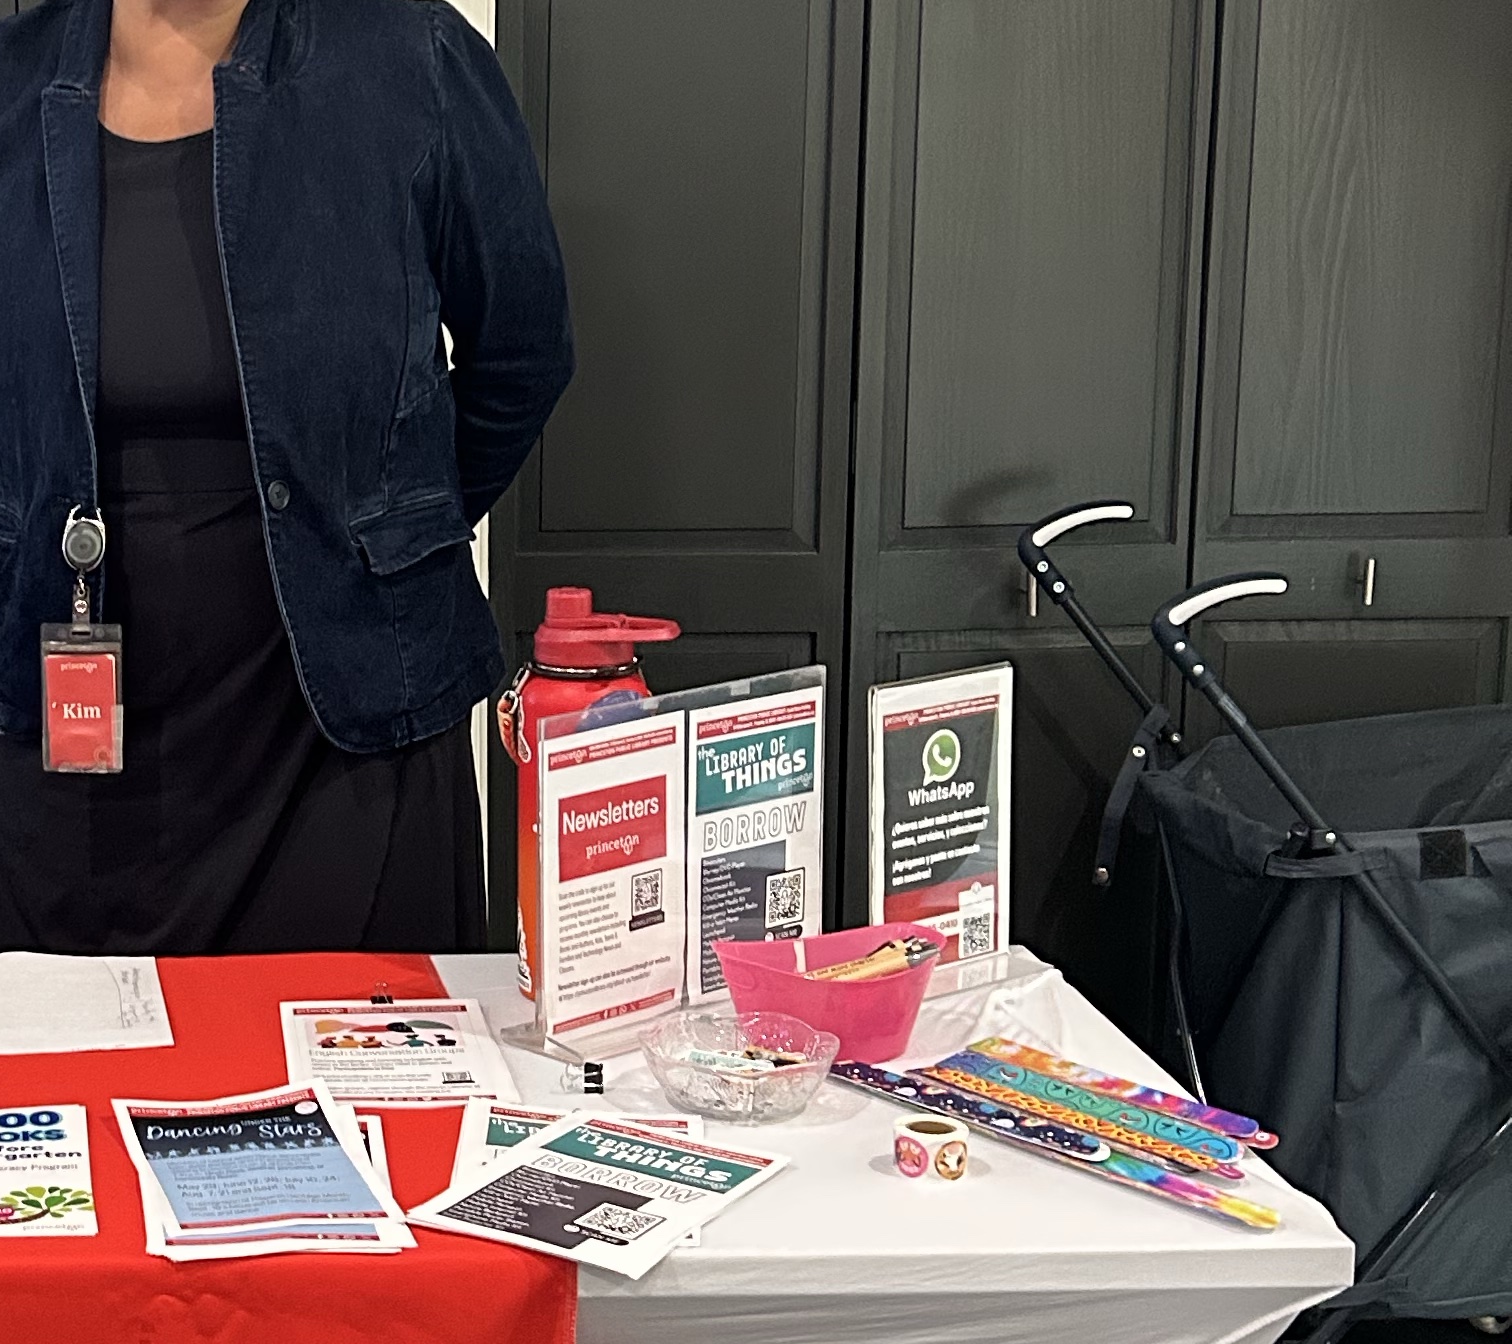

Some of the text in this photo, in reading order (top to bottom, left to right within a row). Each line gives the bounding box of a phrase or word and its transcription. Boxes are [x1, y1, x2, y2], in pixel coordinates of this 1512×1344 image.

[63, 703, 102, 719] Kim
[698, 745, 716, 761] the
[705, 735, 786, 776] LIBRARY OF
[721, 748, 807, 794] THINGS
[908, 780, 975, 807] WhatsApp
[562, 796, 660, 835] Newsletters
[703, 800, 807, 853] BORROW
[586, 834, 639, 860] princeton
[146, 1122, 323, 1140] Dancing Stars
[274, 1115, 292, 1124] THE
[575, 1126, 601, 1139] the
[578, 1133, 710, 1167] LIBRARY OF
[593, 1142, 732, 1183] THINGS
[531, 1154, 707, 1204] BORROW
